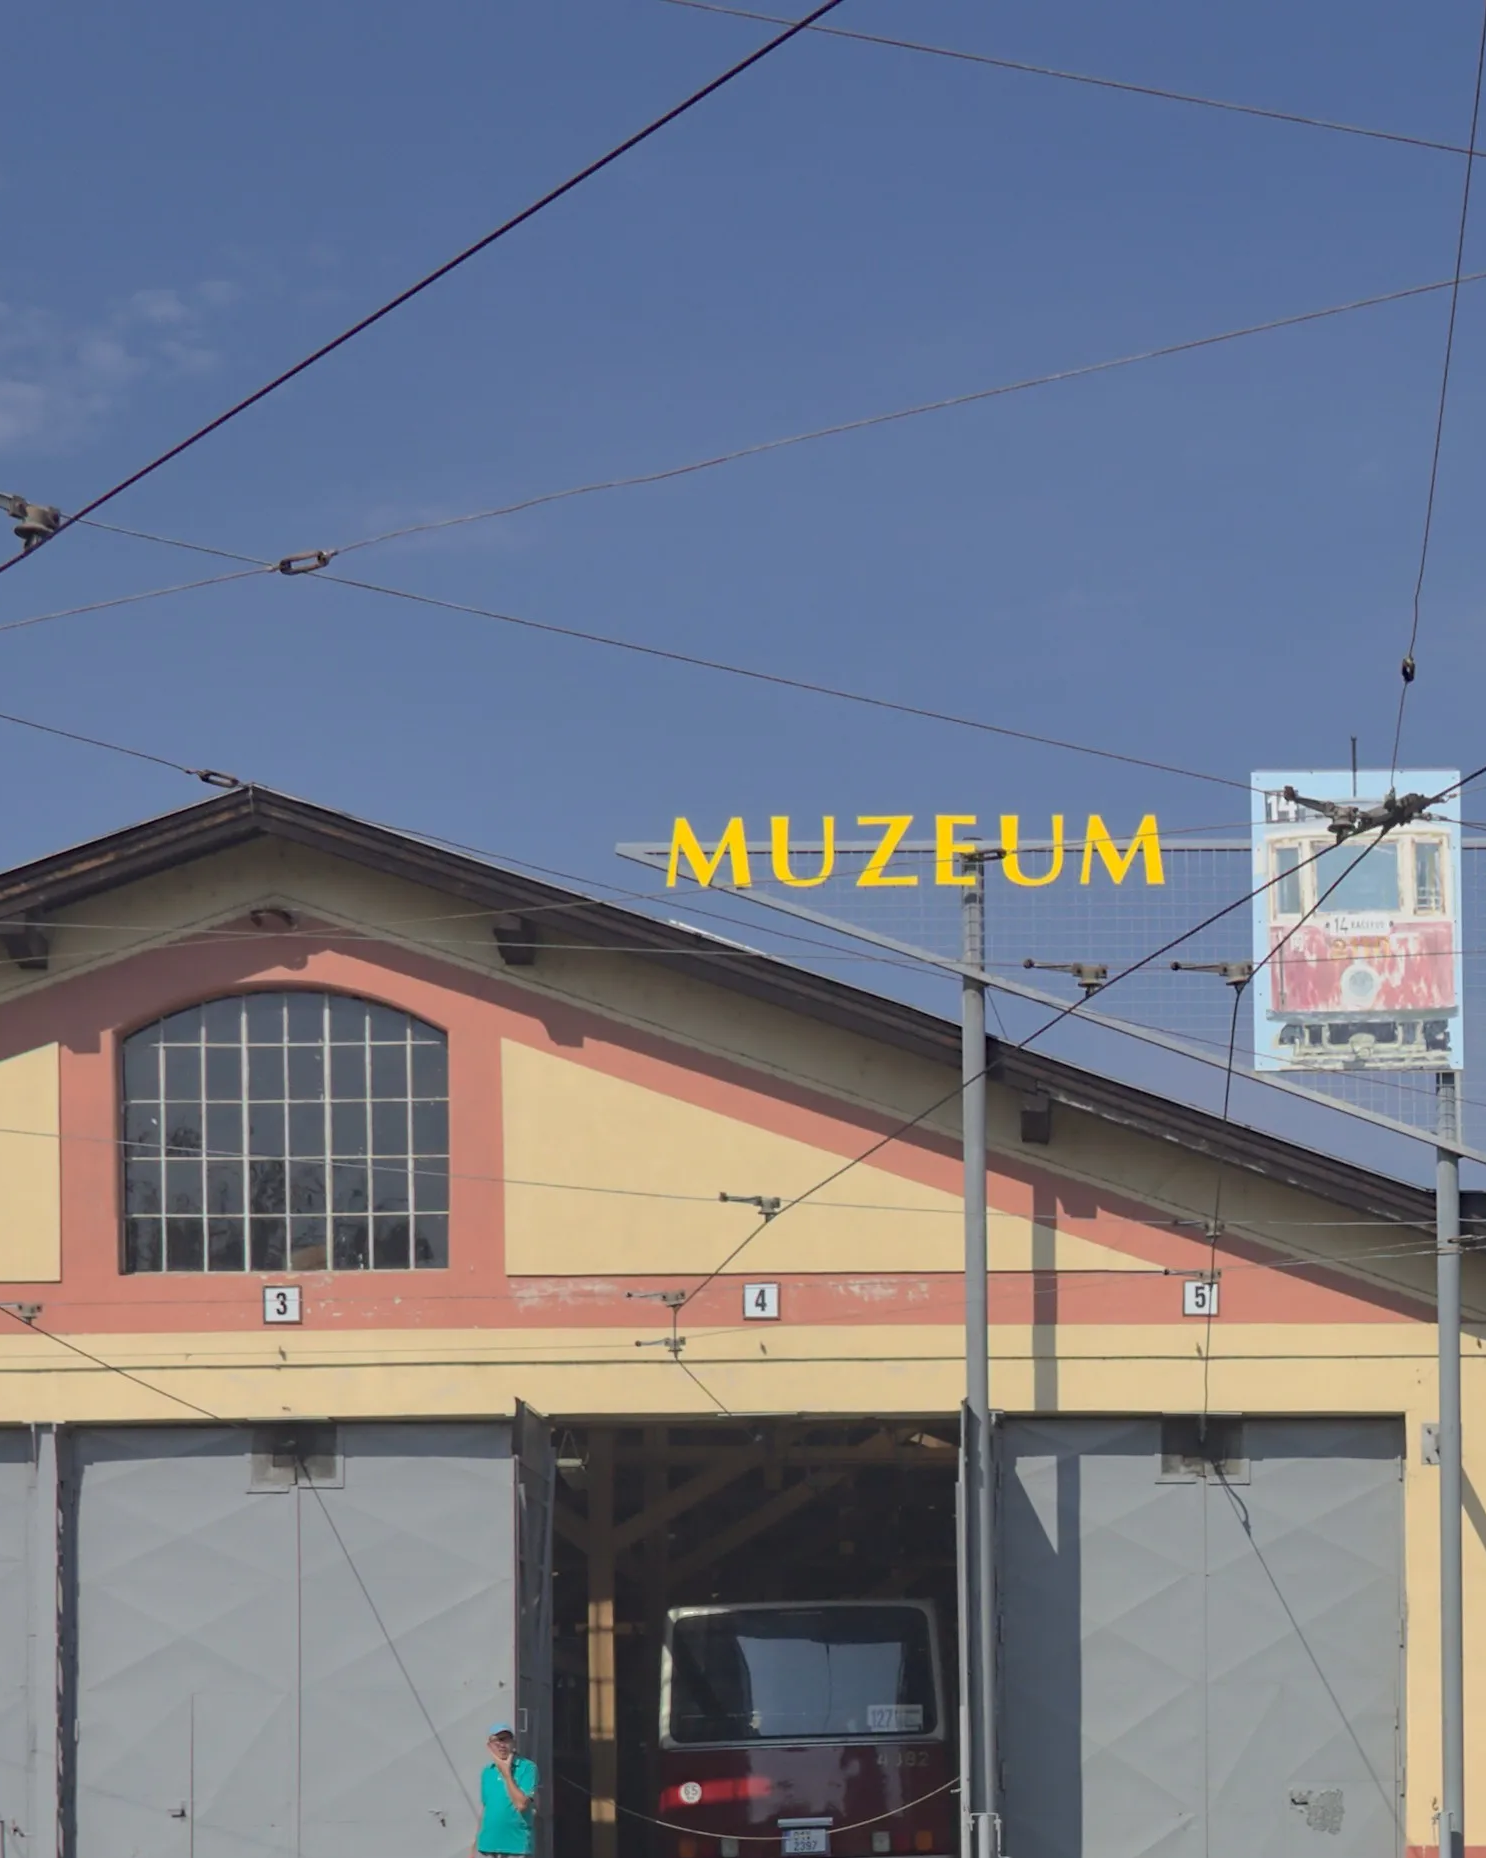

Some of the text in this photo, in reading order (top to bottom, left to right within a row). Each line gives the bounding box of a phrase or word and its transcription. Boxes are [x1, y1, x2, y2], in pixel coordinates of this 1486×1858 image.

[665, 814, 1165, 888] MUZEUM
[1335, 917, 1348, 934] 14
[276, 1293, 288, 1316] 3
[754, 1289, 767, 1311] 4
[1194, 1286, 1206, 1308] 5
